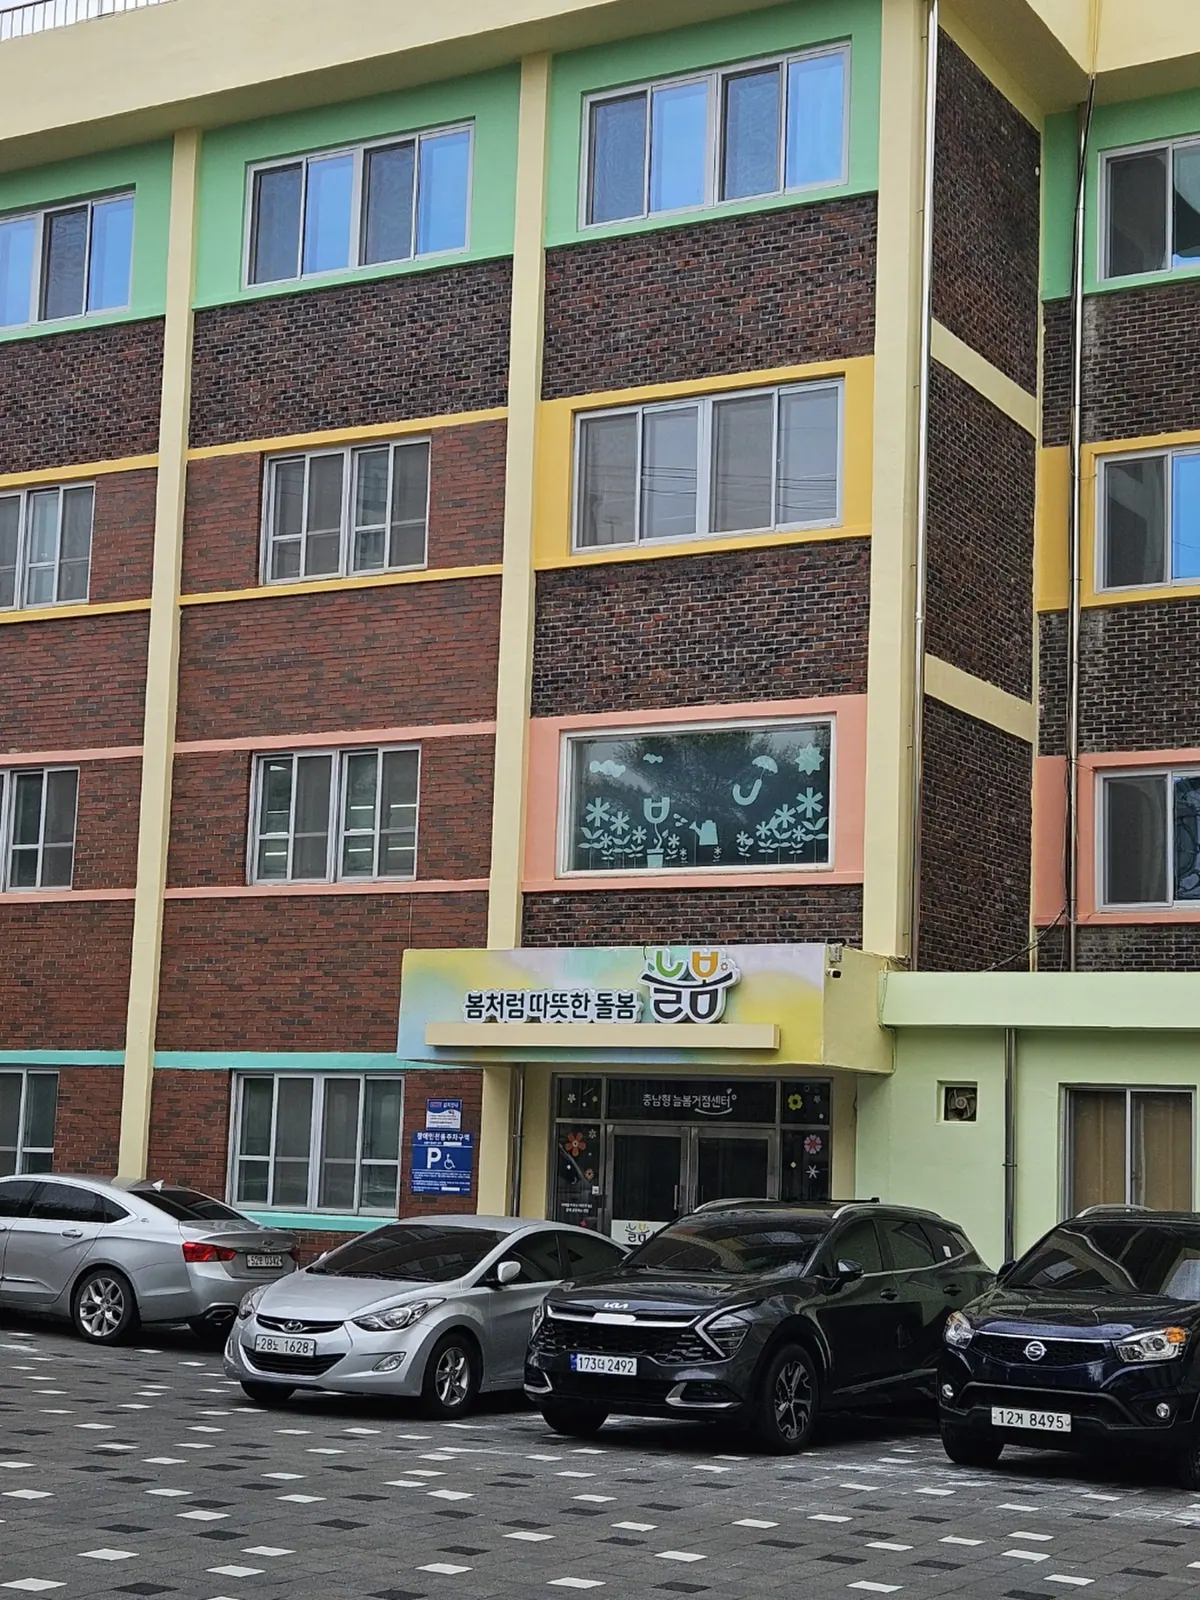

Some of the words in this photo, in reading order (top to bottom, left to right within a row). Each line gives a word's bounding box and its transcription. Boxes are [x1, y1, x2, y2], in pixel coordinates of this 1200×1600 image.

[641, 951, 733, 1019] 늘봄
[465, 993, 525, 1019] 봄처럼
[529, 992, 590, 1019] 따뜻한
[594, 993, 636, 1019] 돌봄
[643, 1093, 671, 1107] 충남형
[673, 1095, 731, 1108] 늘봄거점센터
[427, 1147, 442, 1169] P
[260, 1337, 279, 1351] 28노
[284, 1339, 309, 1354] 1628
[579, 1356, 605, 1370] 173더
[607, 1358, 634, 1374] 2492
[999, 1410, 1024, 1425] 12거
[1029, 1413, 1064, 1429] 8495
